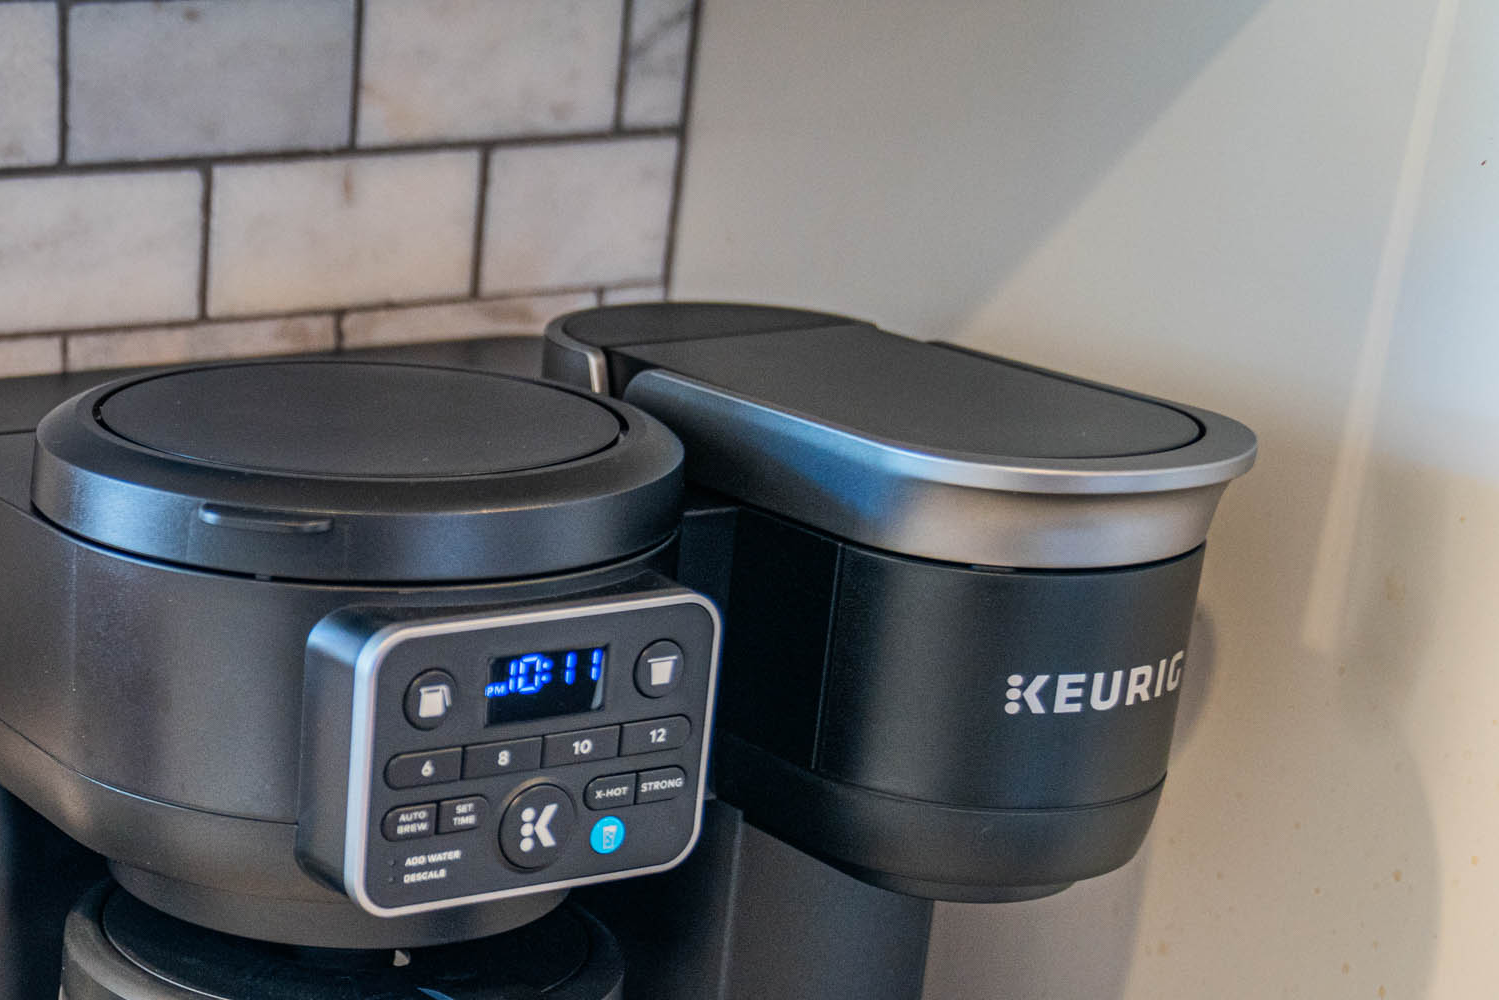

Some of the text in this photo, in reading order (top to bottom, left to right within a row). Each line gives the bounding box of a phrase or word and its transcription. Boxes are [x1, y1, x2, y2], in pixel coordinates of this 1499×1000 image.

[485, 647, 604, 698] PM 10:11
[1005, 650, 1184, 714] KEURIG
[421, 728, 666, 777] 6 8 10 12
[595, 776, 683, 799] X-HOT STRONG
[399, 810, 426, 823] AUTO
[455, 803, 474, 815] SET
[397, 821, 428, 834] BREW
[452, 814, 476, 826] TIME
[405, 850, 461, 866] ADD WATER
[403, 868, 446, 883] DESCALE
